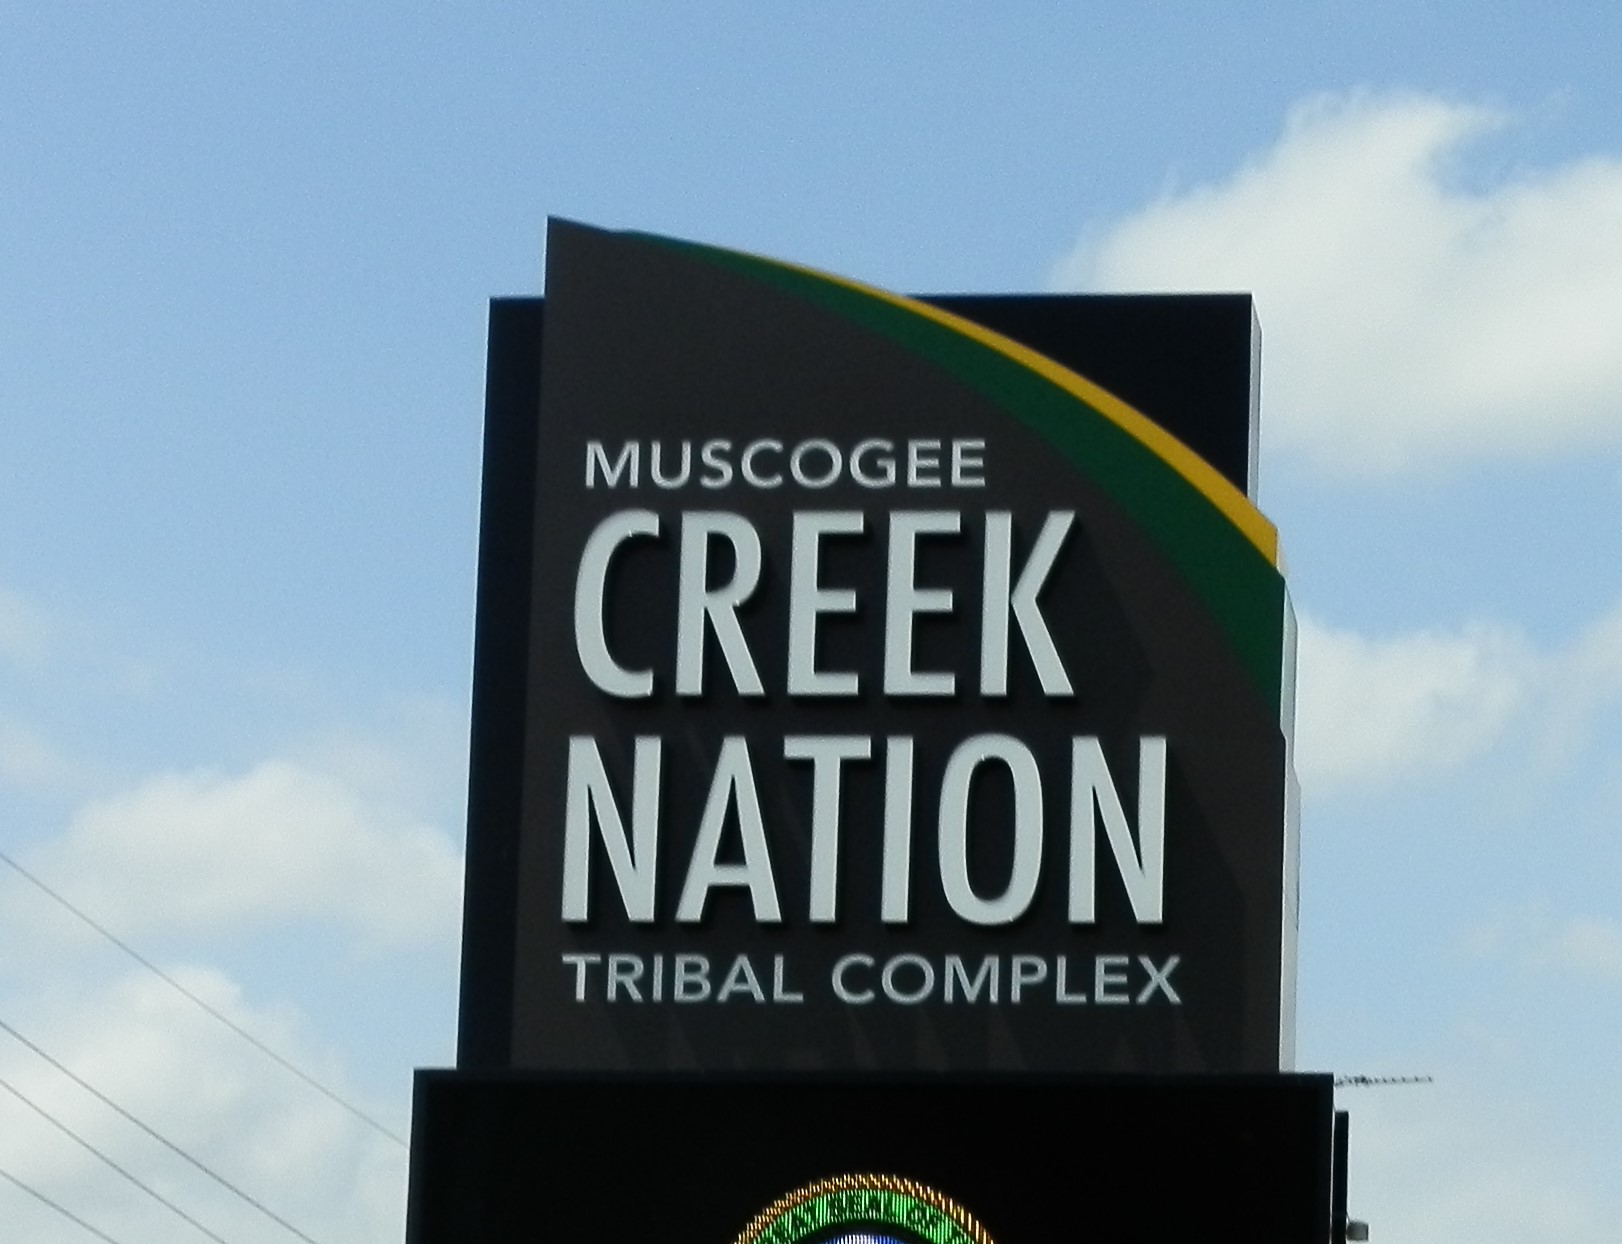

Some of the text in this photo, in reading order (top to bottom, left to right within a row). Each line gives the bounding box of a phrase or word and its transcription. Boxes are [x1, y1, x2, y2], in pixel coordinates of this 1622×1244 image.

[584, 438, 987, 490] MUSCOGEE
[574, 508, 1076, 698] CREEK
[561, 732, 1168, 926] NATION
[561, 953, 1182, 1005] TRIBAL COMPLEX
[826, 1192, 897, 1219] SEAL
[905, 1203, 948, 1233] OF
